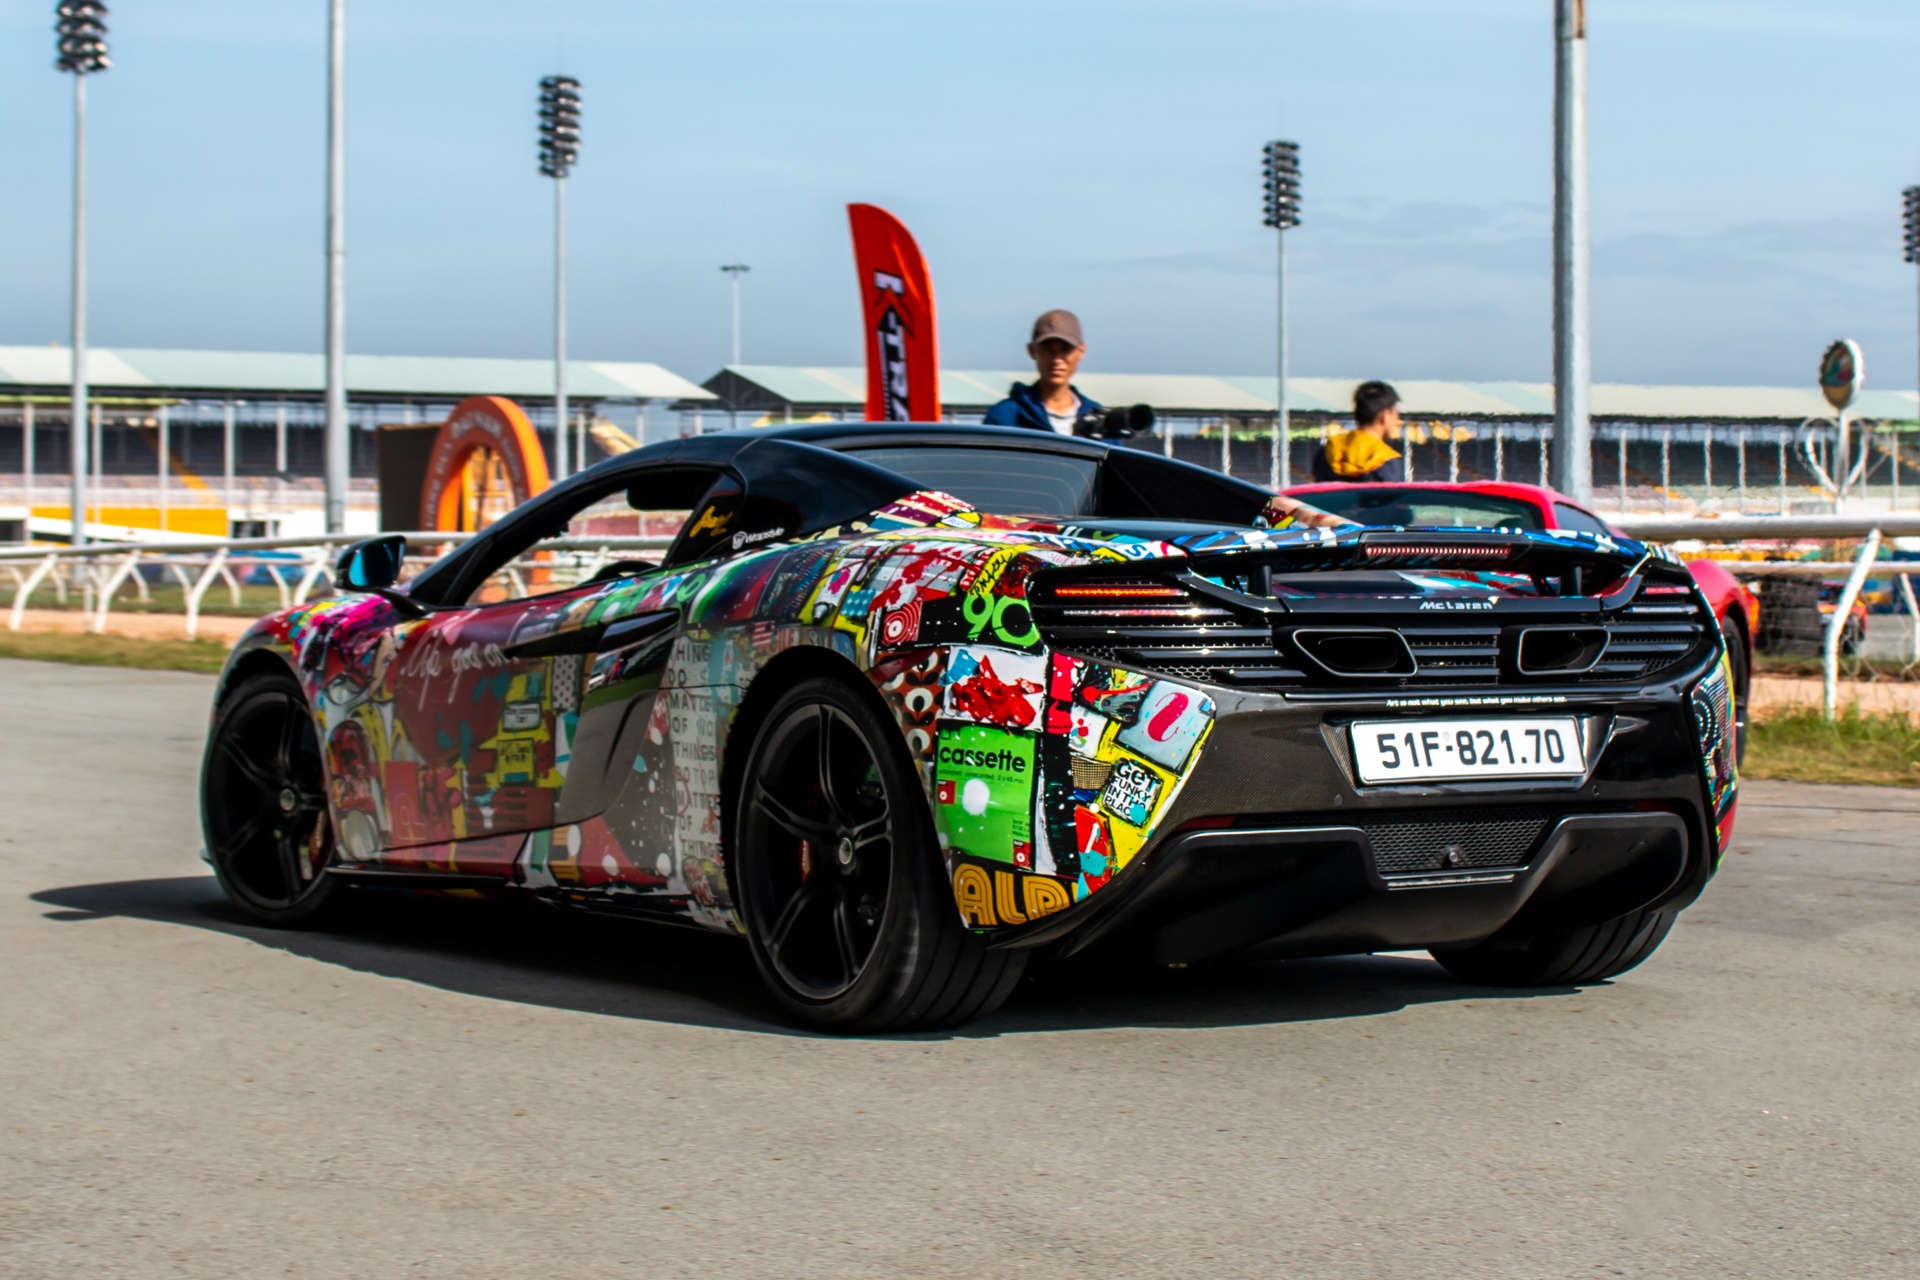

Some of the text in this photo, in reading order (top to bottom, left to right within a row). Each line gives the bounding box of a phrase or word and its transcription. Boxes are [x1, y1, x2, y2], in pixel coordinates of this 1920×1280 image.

[1419, 601, 1493, 610] McLaren
[1386, 699, 1399, 707] Art
[1421, 698, 1440, 706] what
[1440, 699, 1453, 707] you
[1469, 697, 1482, 705] but
[1500, 697, 1513, 705] you
[1513, 696, 1532, 704] make
[1532, 695, 1552, 704] others
[1376, 728, 1565, 769] 51F-821.70
[940, 746, 1026, 773] cassette
[1108, 785, 1121, 799] IN
[1111, 776, 1152, 801] FUNKY
